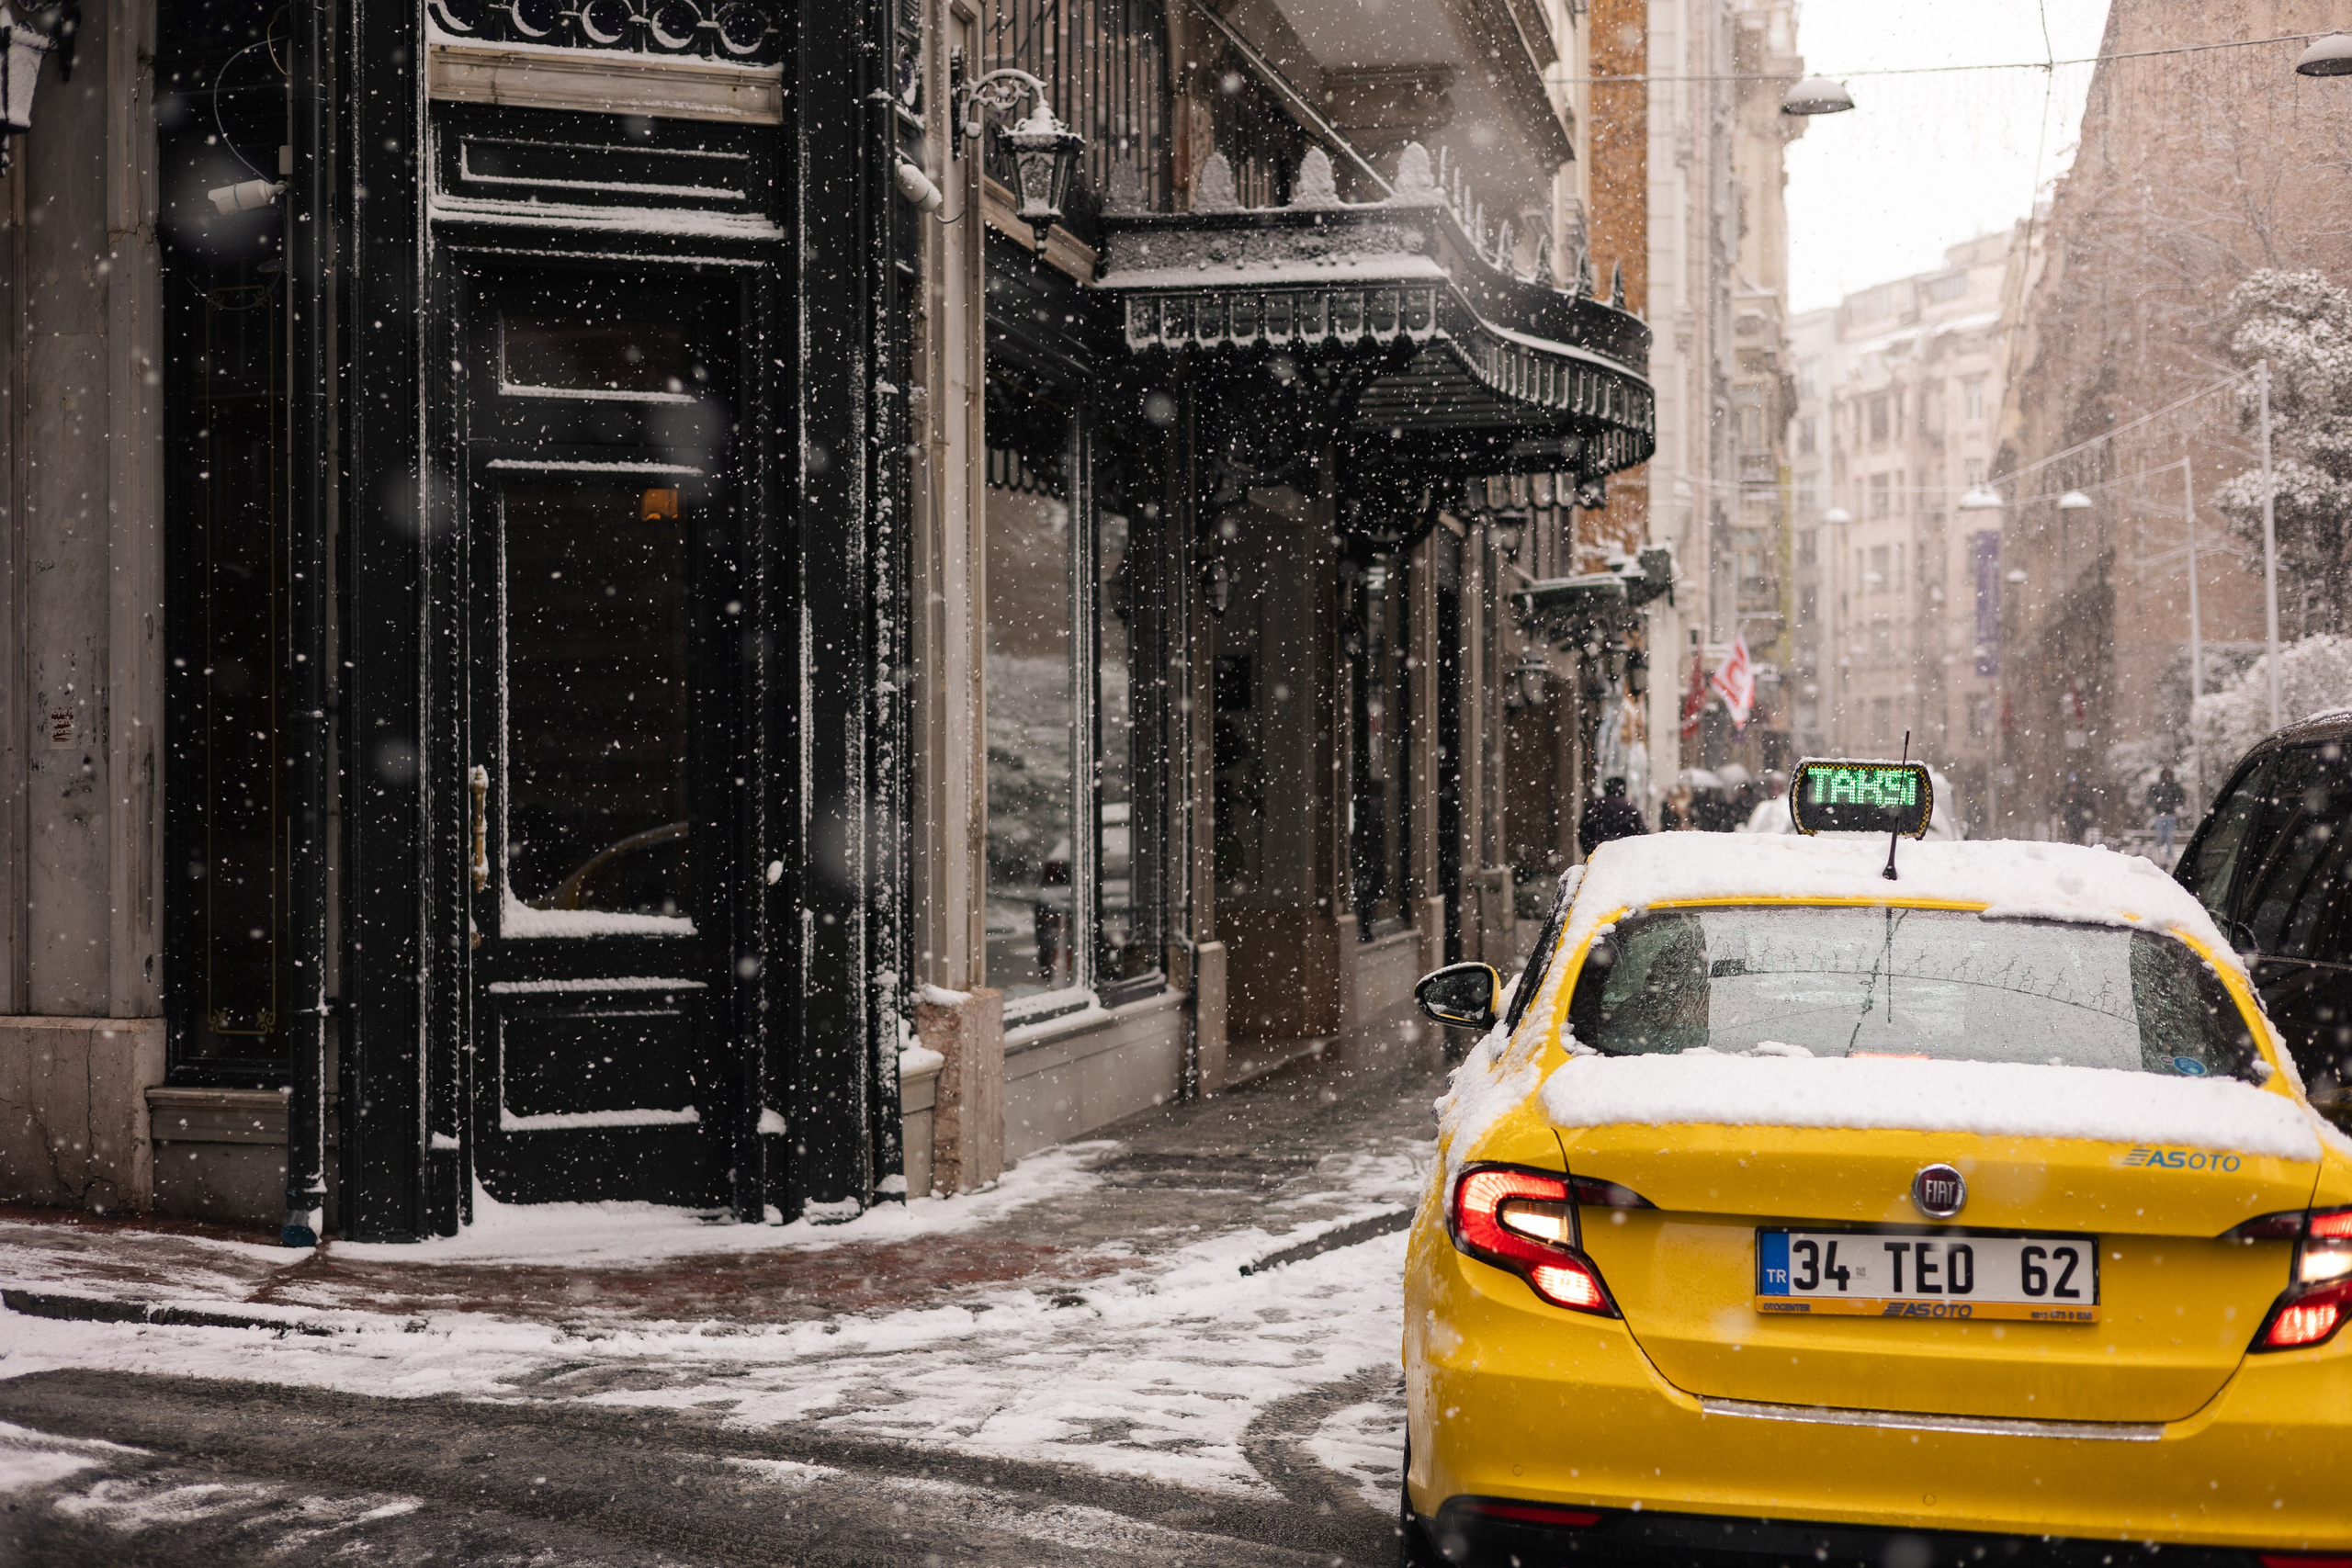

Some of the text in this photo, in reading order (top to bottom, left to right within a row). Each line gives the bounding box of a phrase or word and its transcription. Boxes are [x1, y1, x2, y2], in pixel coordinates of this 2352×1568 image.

[1926, 1179, 1956, 1204] FIAT
[1766, 1269, 1787, 1283] TR
[1792, 1240, 2080, 1298] 34 TED 62
[1764, 1303, 1811, 1312] OTOCENTER
